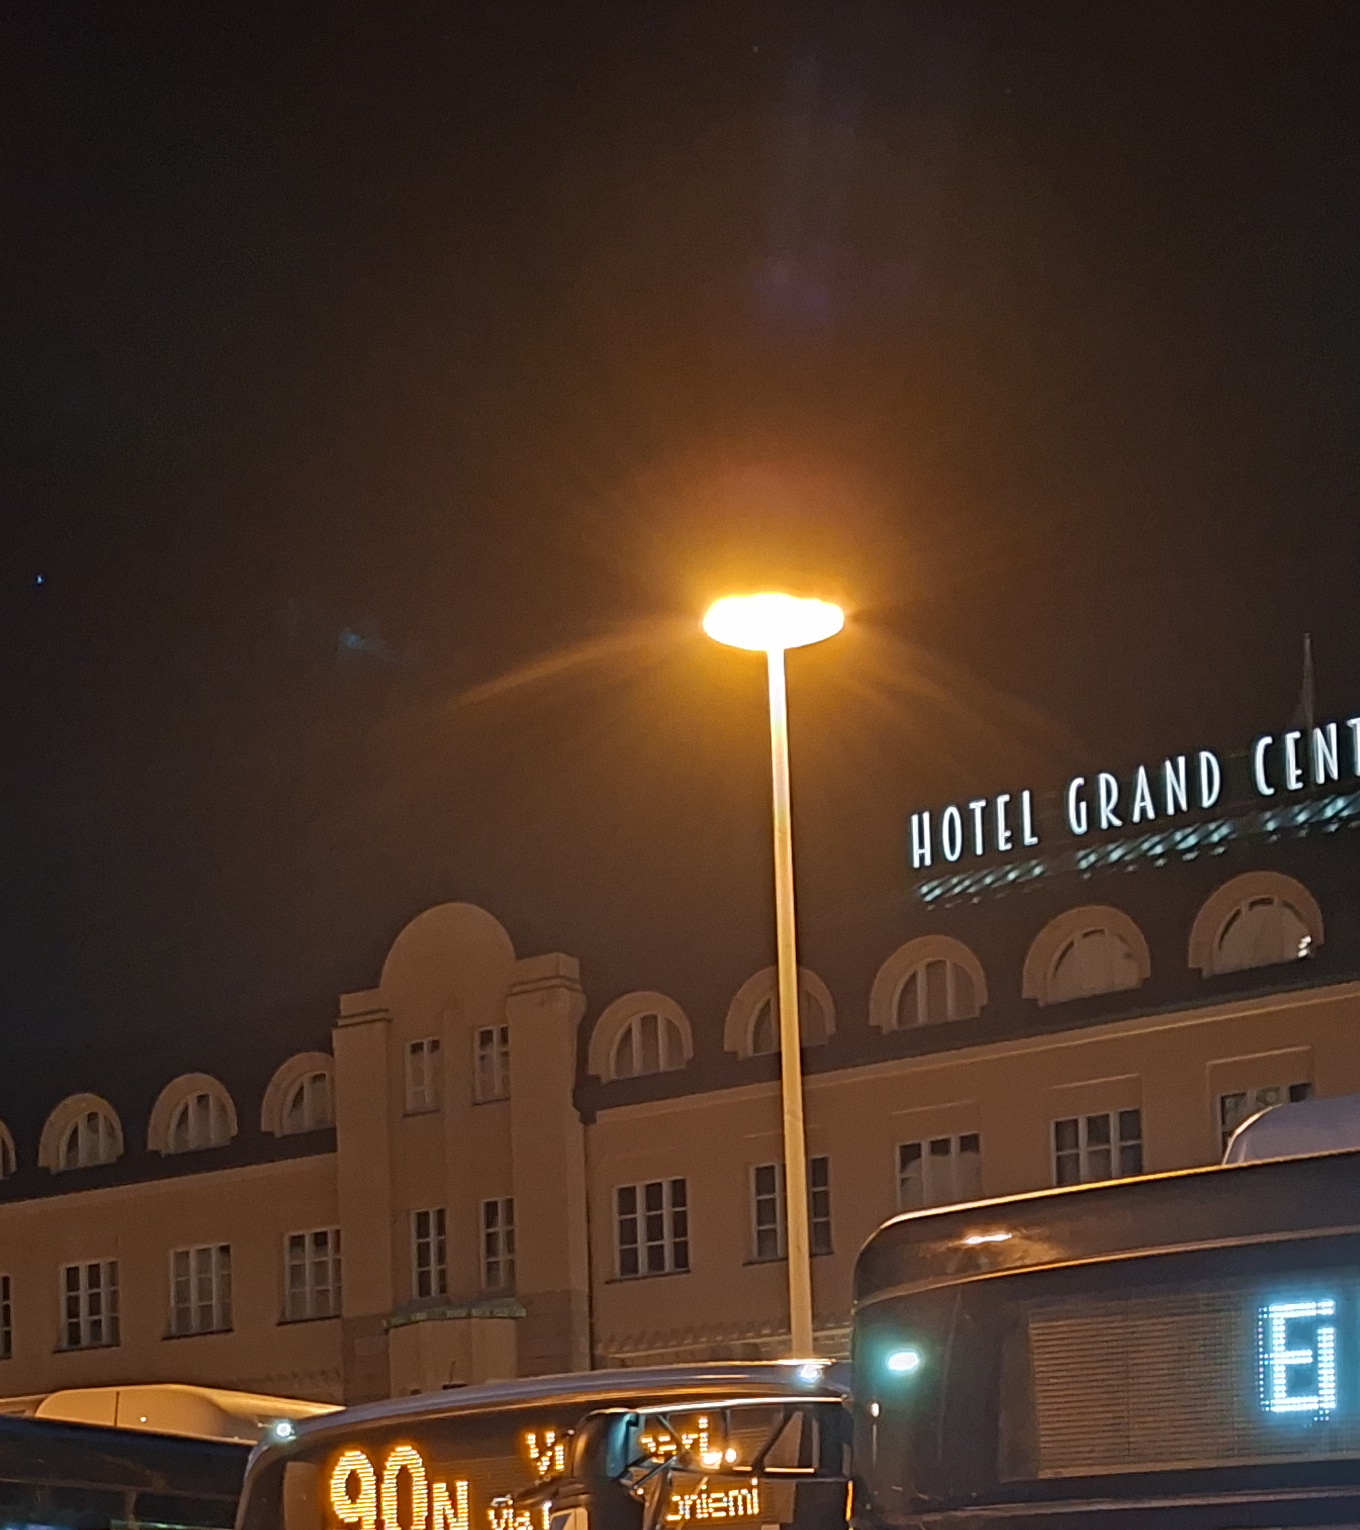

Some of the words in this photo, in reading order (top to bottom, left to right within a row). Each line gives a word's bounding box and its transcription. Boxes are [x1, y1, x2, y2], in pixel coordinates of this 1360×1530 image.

[909, 790, 1039, 869] HOTEL
[1068, 750, 1221, 835] GRAND
[1258, 1299, 1337, 1413] Ei
